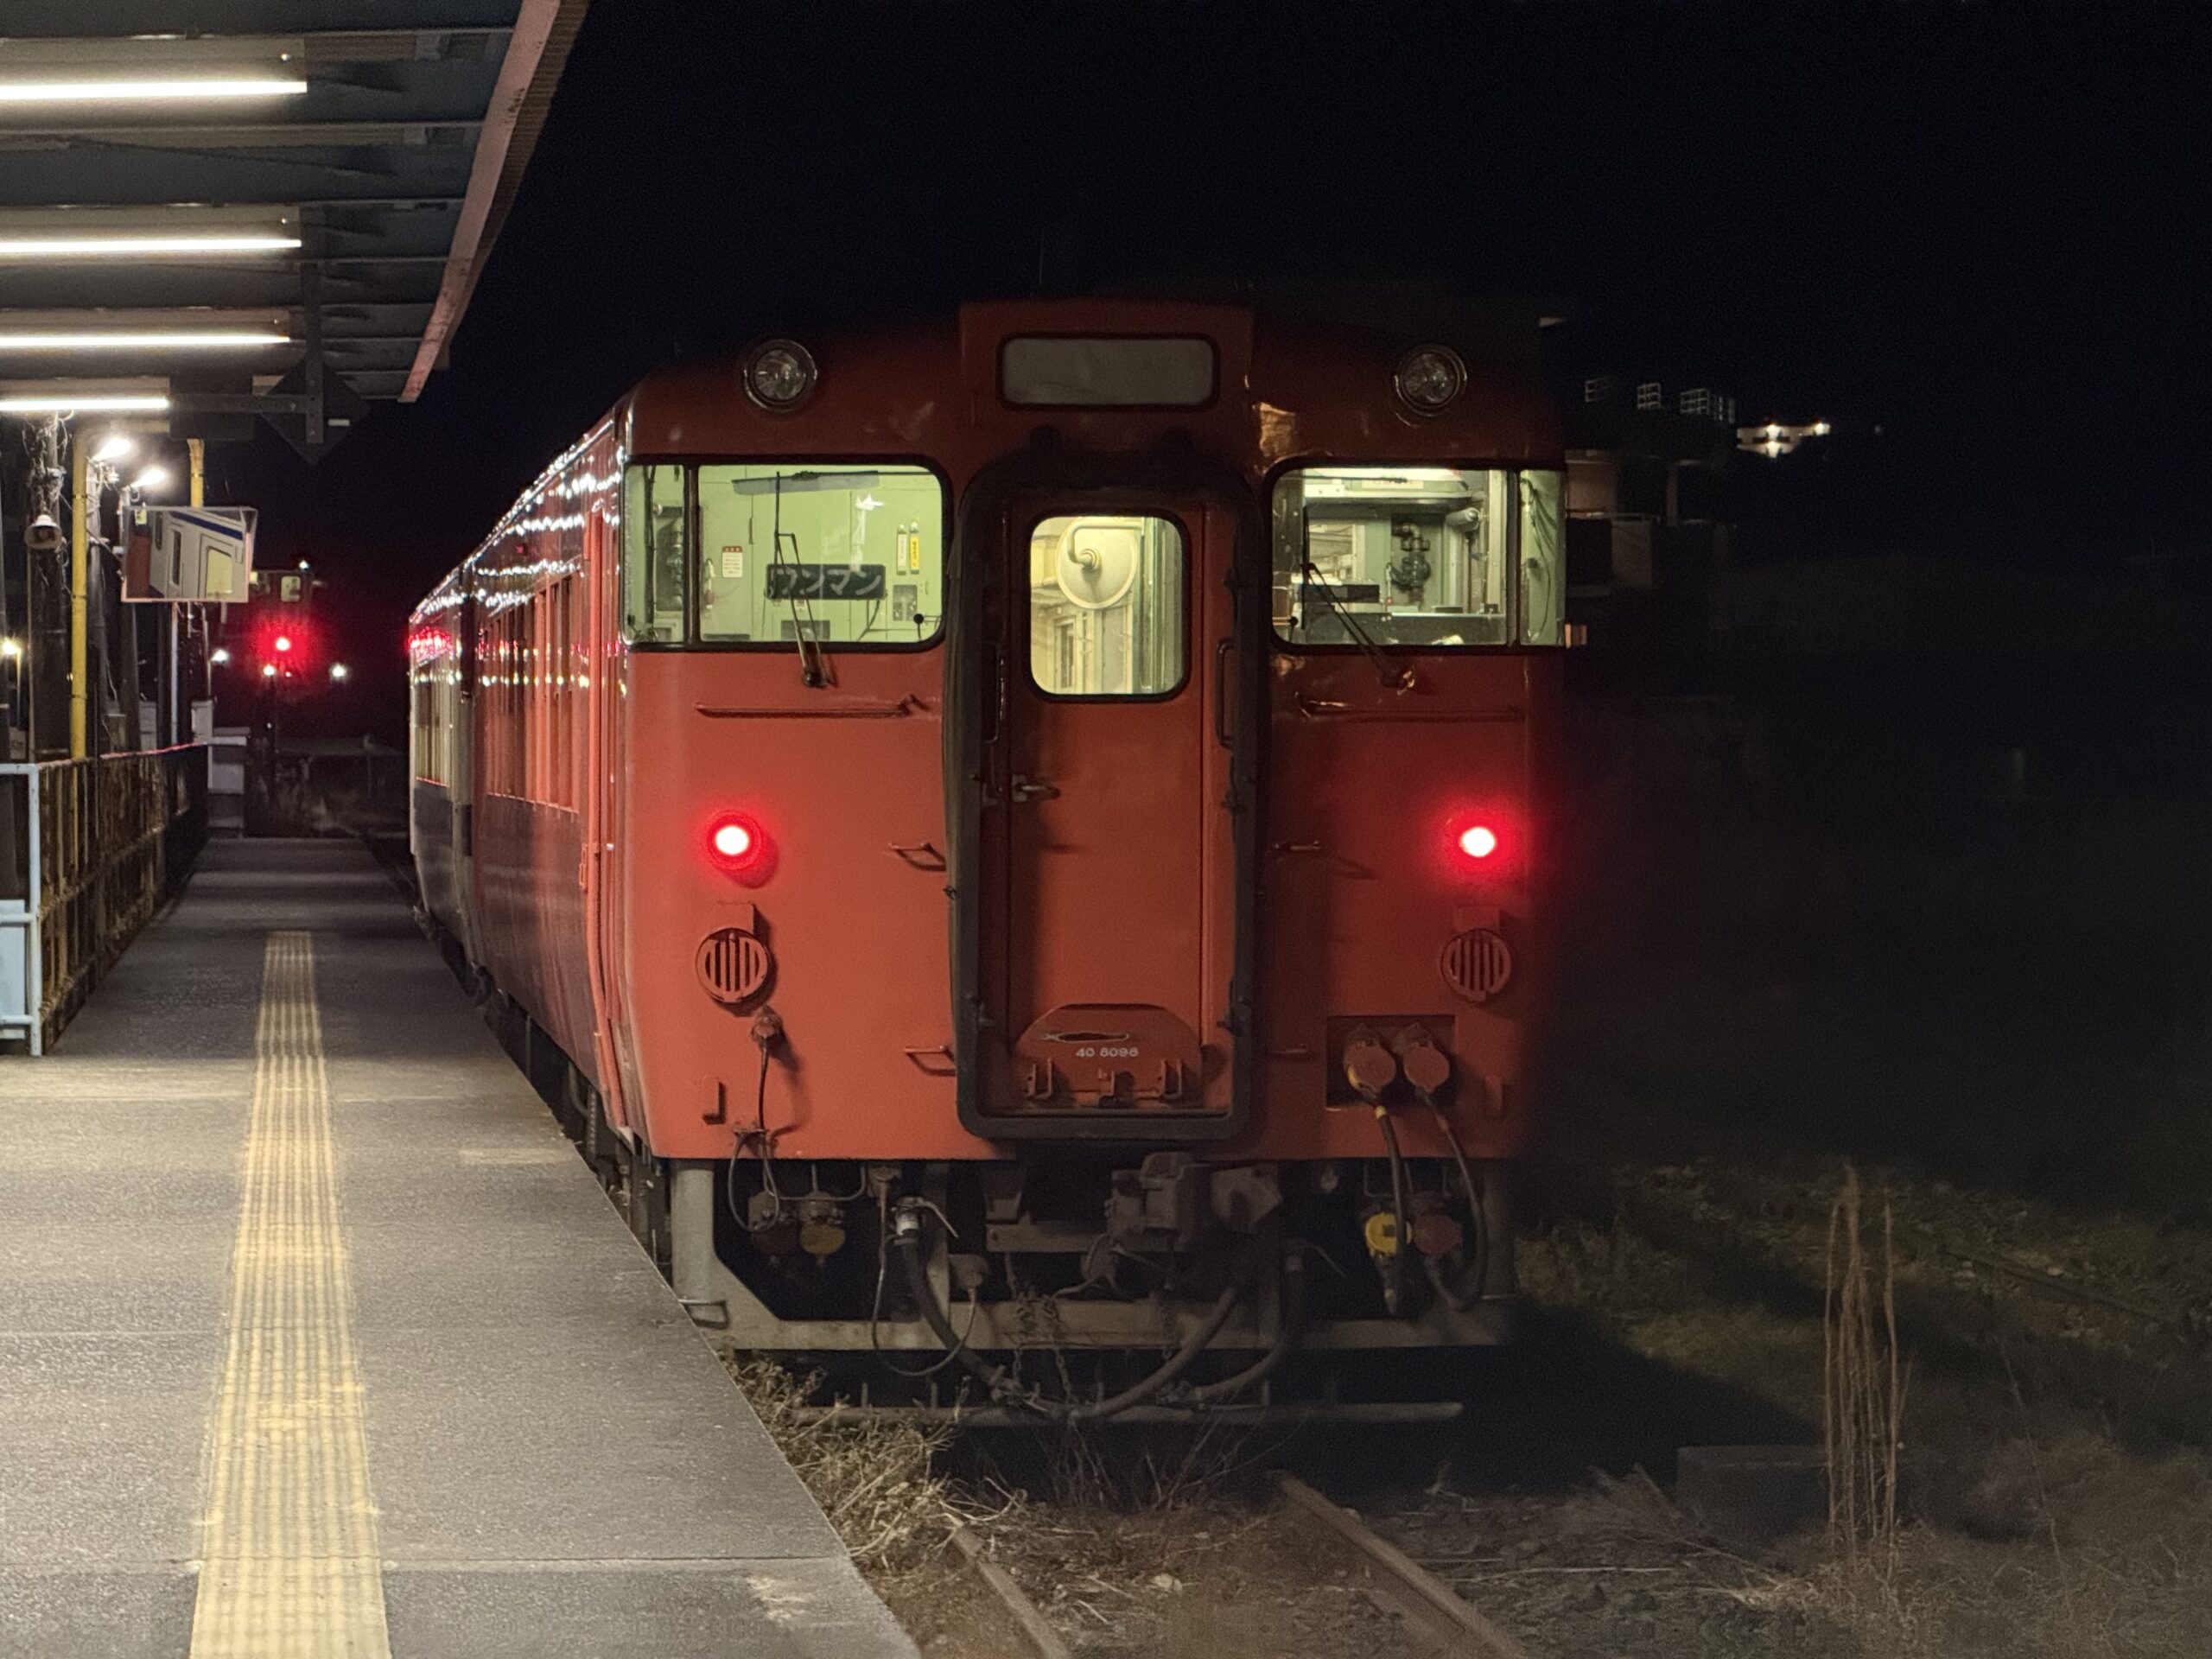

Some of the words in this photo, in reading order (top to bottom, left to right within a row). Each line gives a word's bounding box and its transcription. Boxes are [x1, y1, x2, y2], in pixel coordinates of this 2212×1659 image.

[770, 567, 882, 595] ワンマン
[1076, 1047, 1095, 1058] 40
